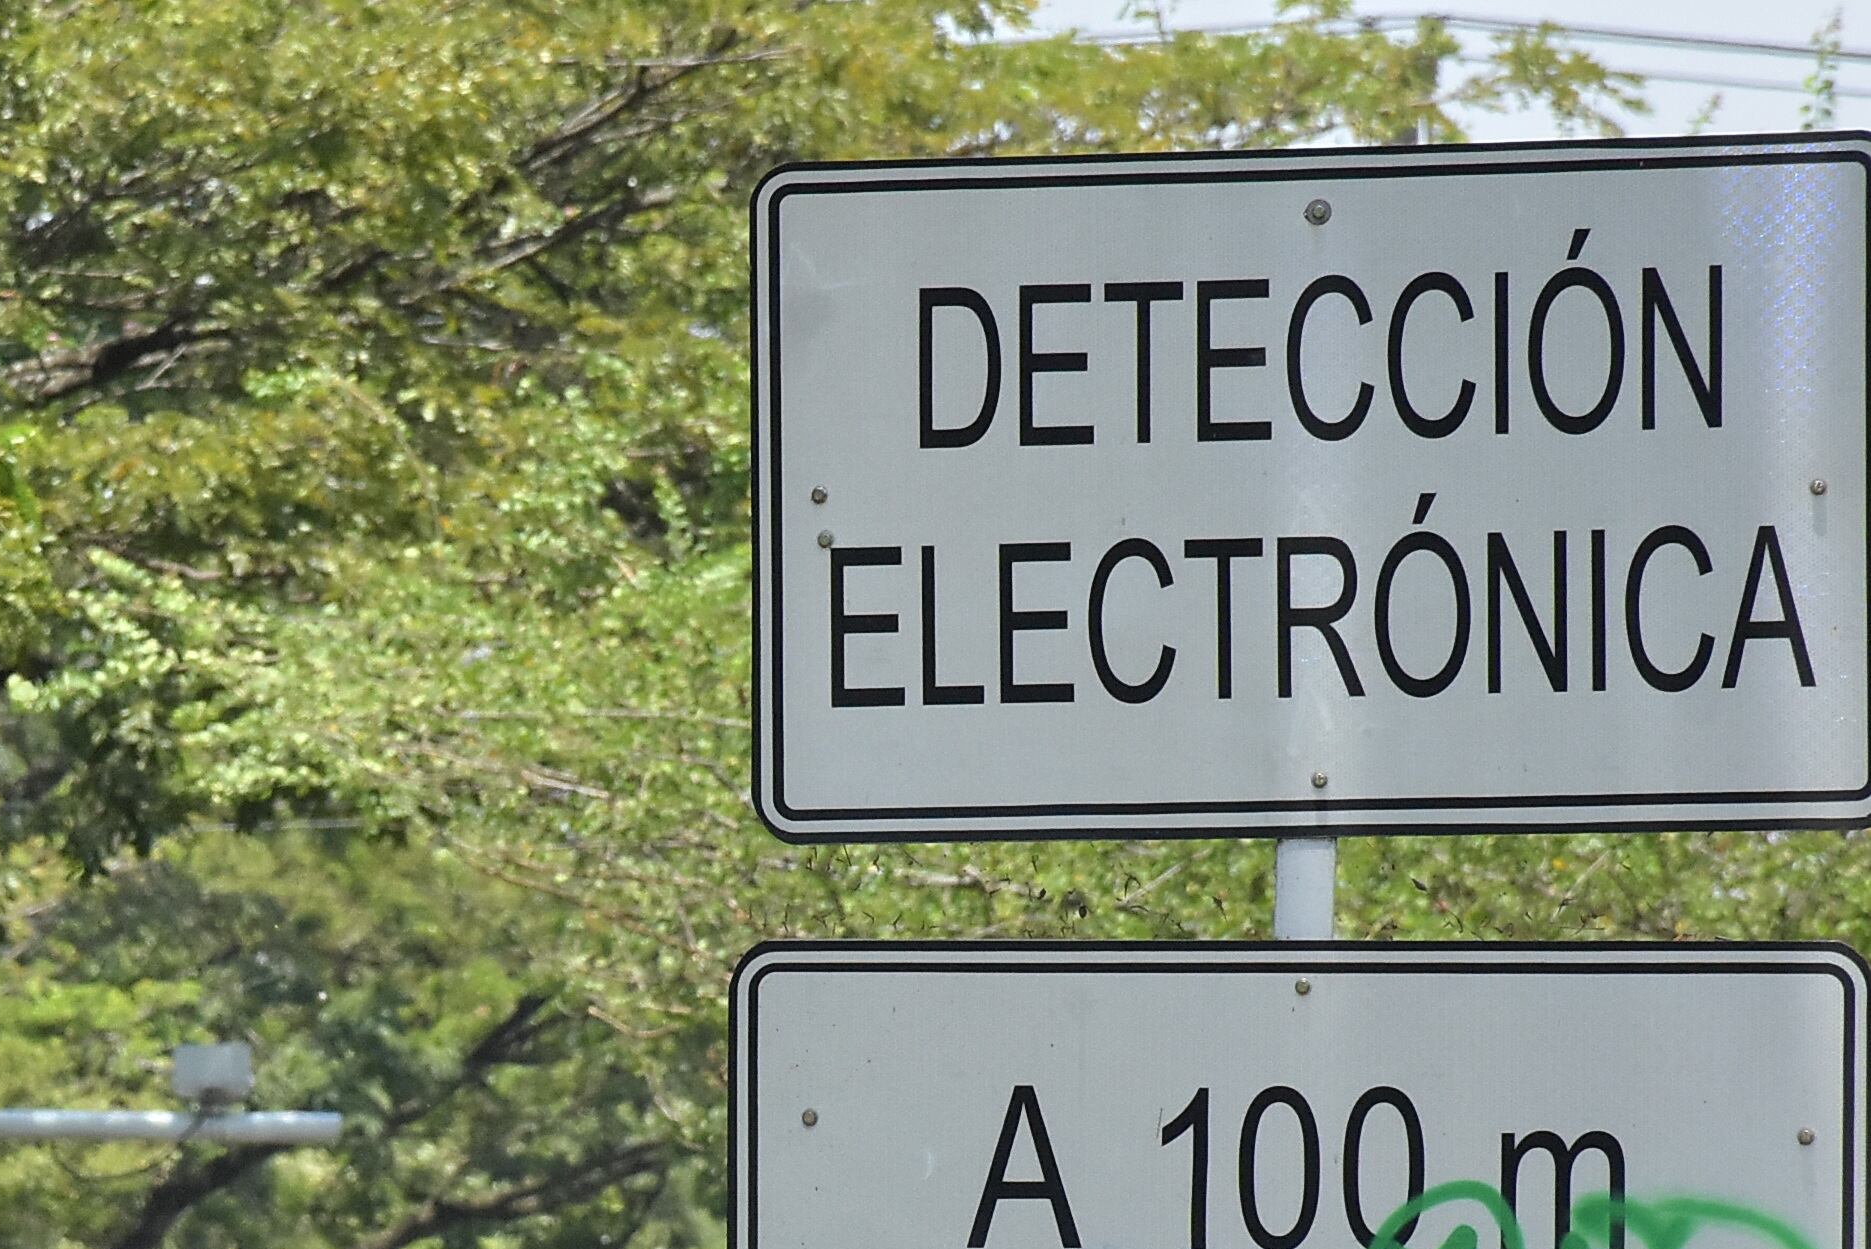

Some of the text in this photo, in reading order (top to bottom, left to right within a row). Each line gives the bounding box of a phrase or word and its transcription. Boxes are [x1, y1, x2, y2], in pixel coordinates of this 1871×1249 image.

[918, 228, 1723, 449] DETECCIÓN
[829, 492, 1818, 708] ELECTRÓNICA
[966, 1085, 1082, 1249] A
